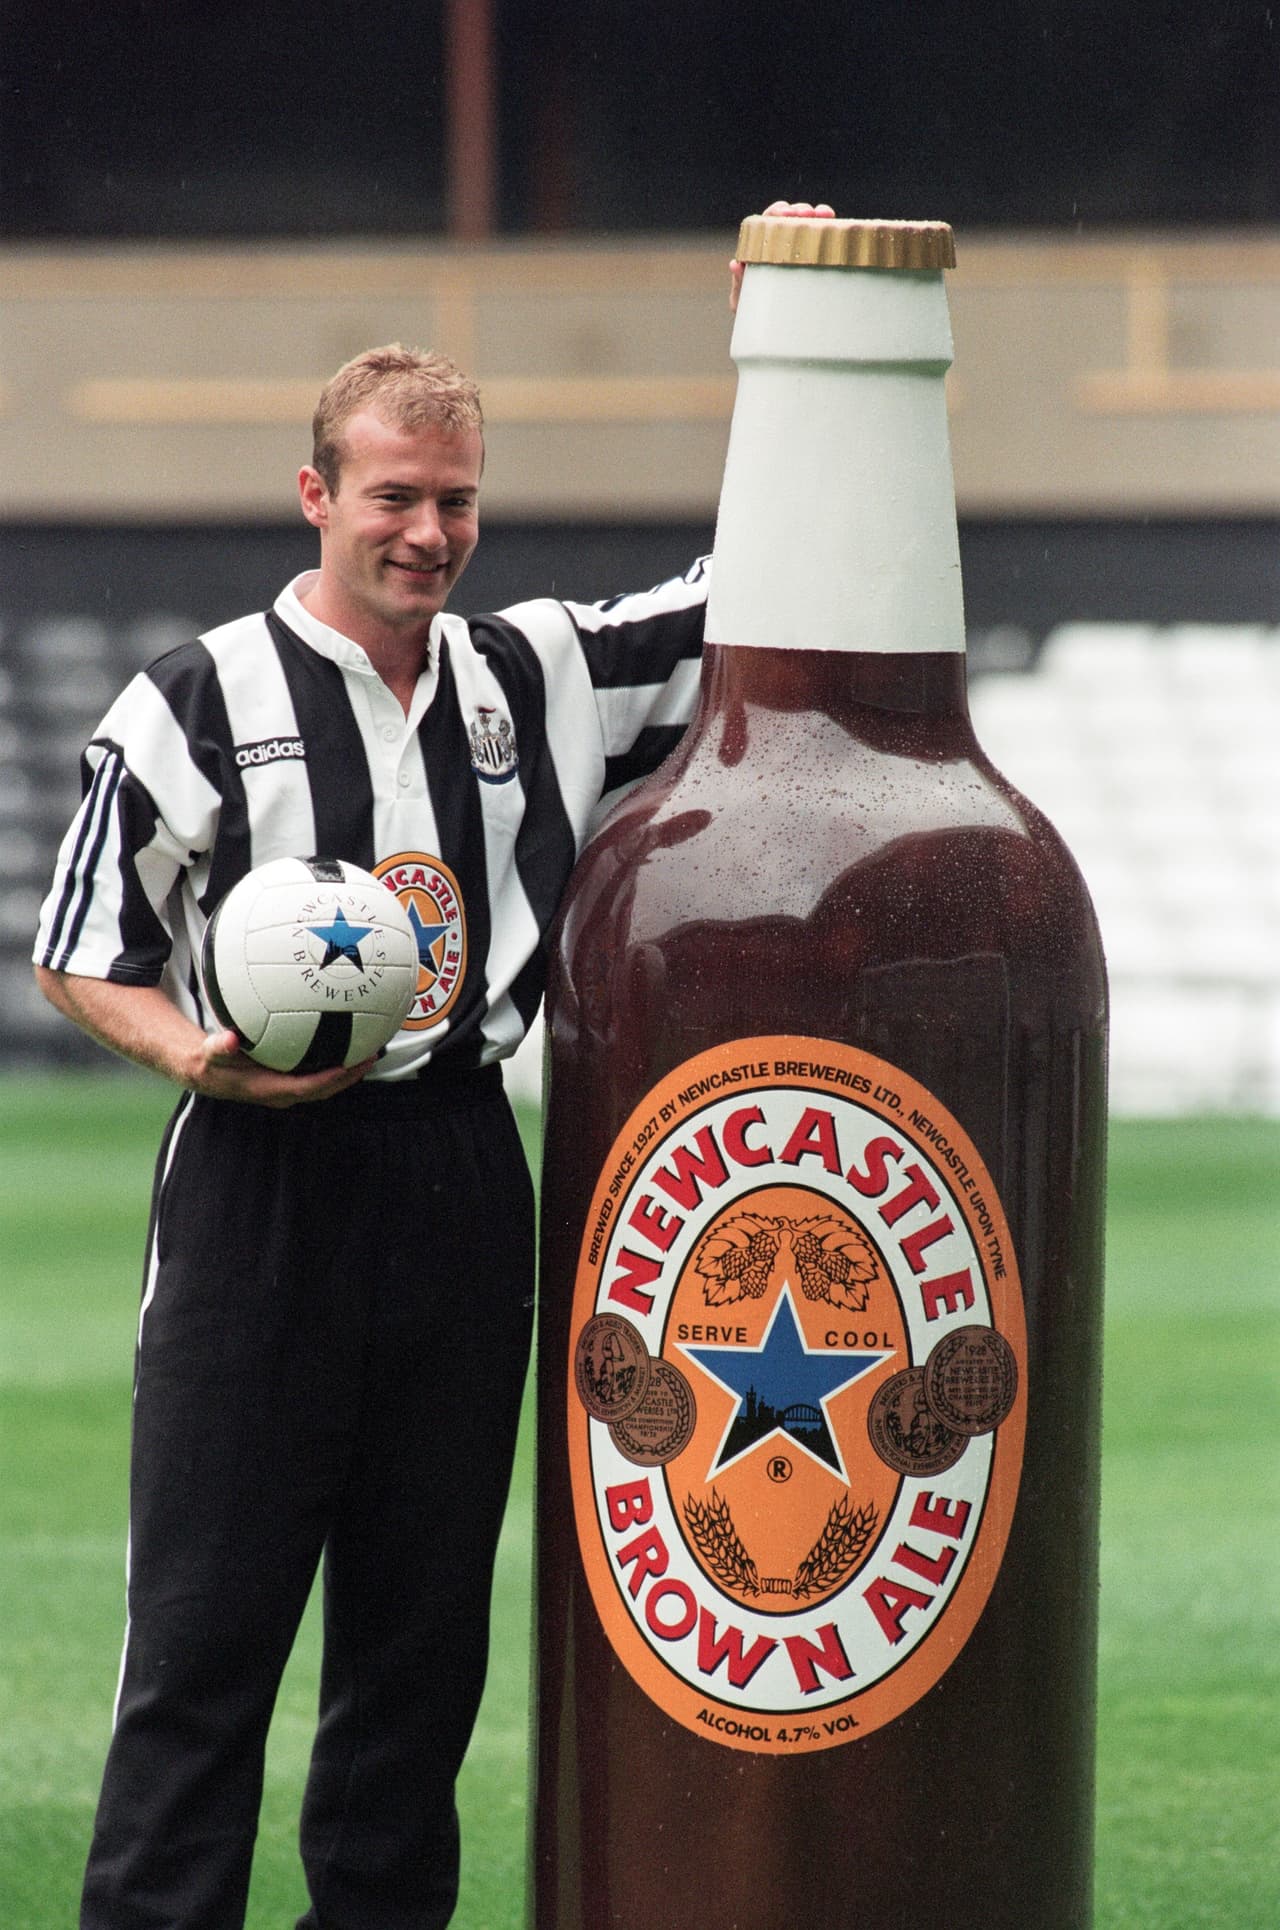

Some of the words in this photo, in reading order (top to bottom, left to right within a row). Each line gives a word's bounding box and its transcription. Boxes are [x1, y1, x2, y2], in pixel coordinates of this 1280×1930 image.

[235, 739, 305, 767] adidas
[293, 950, 386, 1002] BREWERIES
[438, 950, 460, 993] ALE
[588, 1198, 613, 1266] BREWED
[609, 1154, 636, 1198] SINCE
[633, 1119, 660, 1155] 1927
[658, 1100, 678, 1122] BY
[678, 1062, 769, 1107] NEWCASTLE
[774, 1061, 872, 1094] BREWERIES
[908, 1109, 975, 1192] NEWCASTLE
[969, 1191, 994, 1237] UPON
[986, 1236, 1007, 1281] TYNE
[608, 1105, 976, 1322] NEWCASTLE
[678, 1324, 748, 1343] SERVE
[824, 1330, 894, 1348] COOL
[605, 1477, 857, 1696] BROWN
[861, 1491, 972, 1647] ALE
[696, 1708, 771, 1742] ALCOHOL
[776, 1726, 820, 1743] 4.7%
[822, 1714, 859, 1736] VOL
